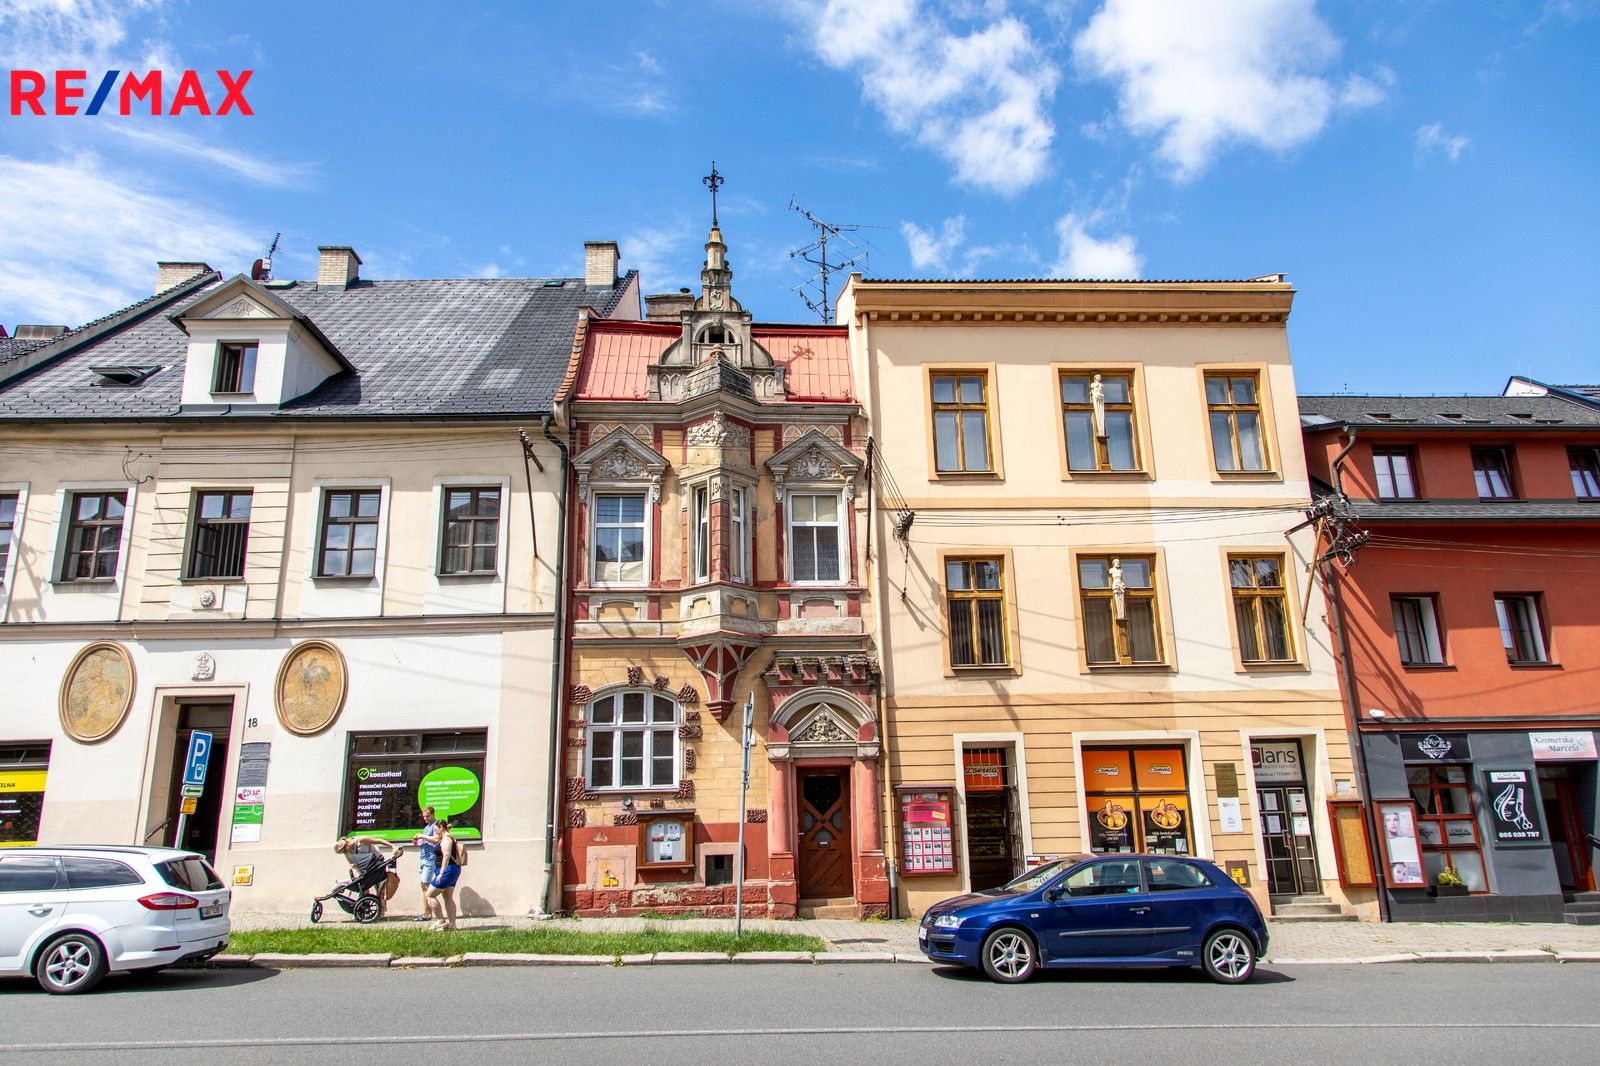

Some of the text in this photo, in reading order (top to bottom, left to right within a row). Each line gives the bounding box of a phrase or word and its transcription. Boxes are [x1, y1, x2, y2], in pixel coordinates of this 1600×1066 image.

[248, 718, 258, 728] 18
[192, 738, 206, 767] P
[1251, 747, 1296, 765] Claris
